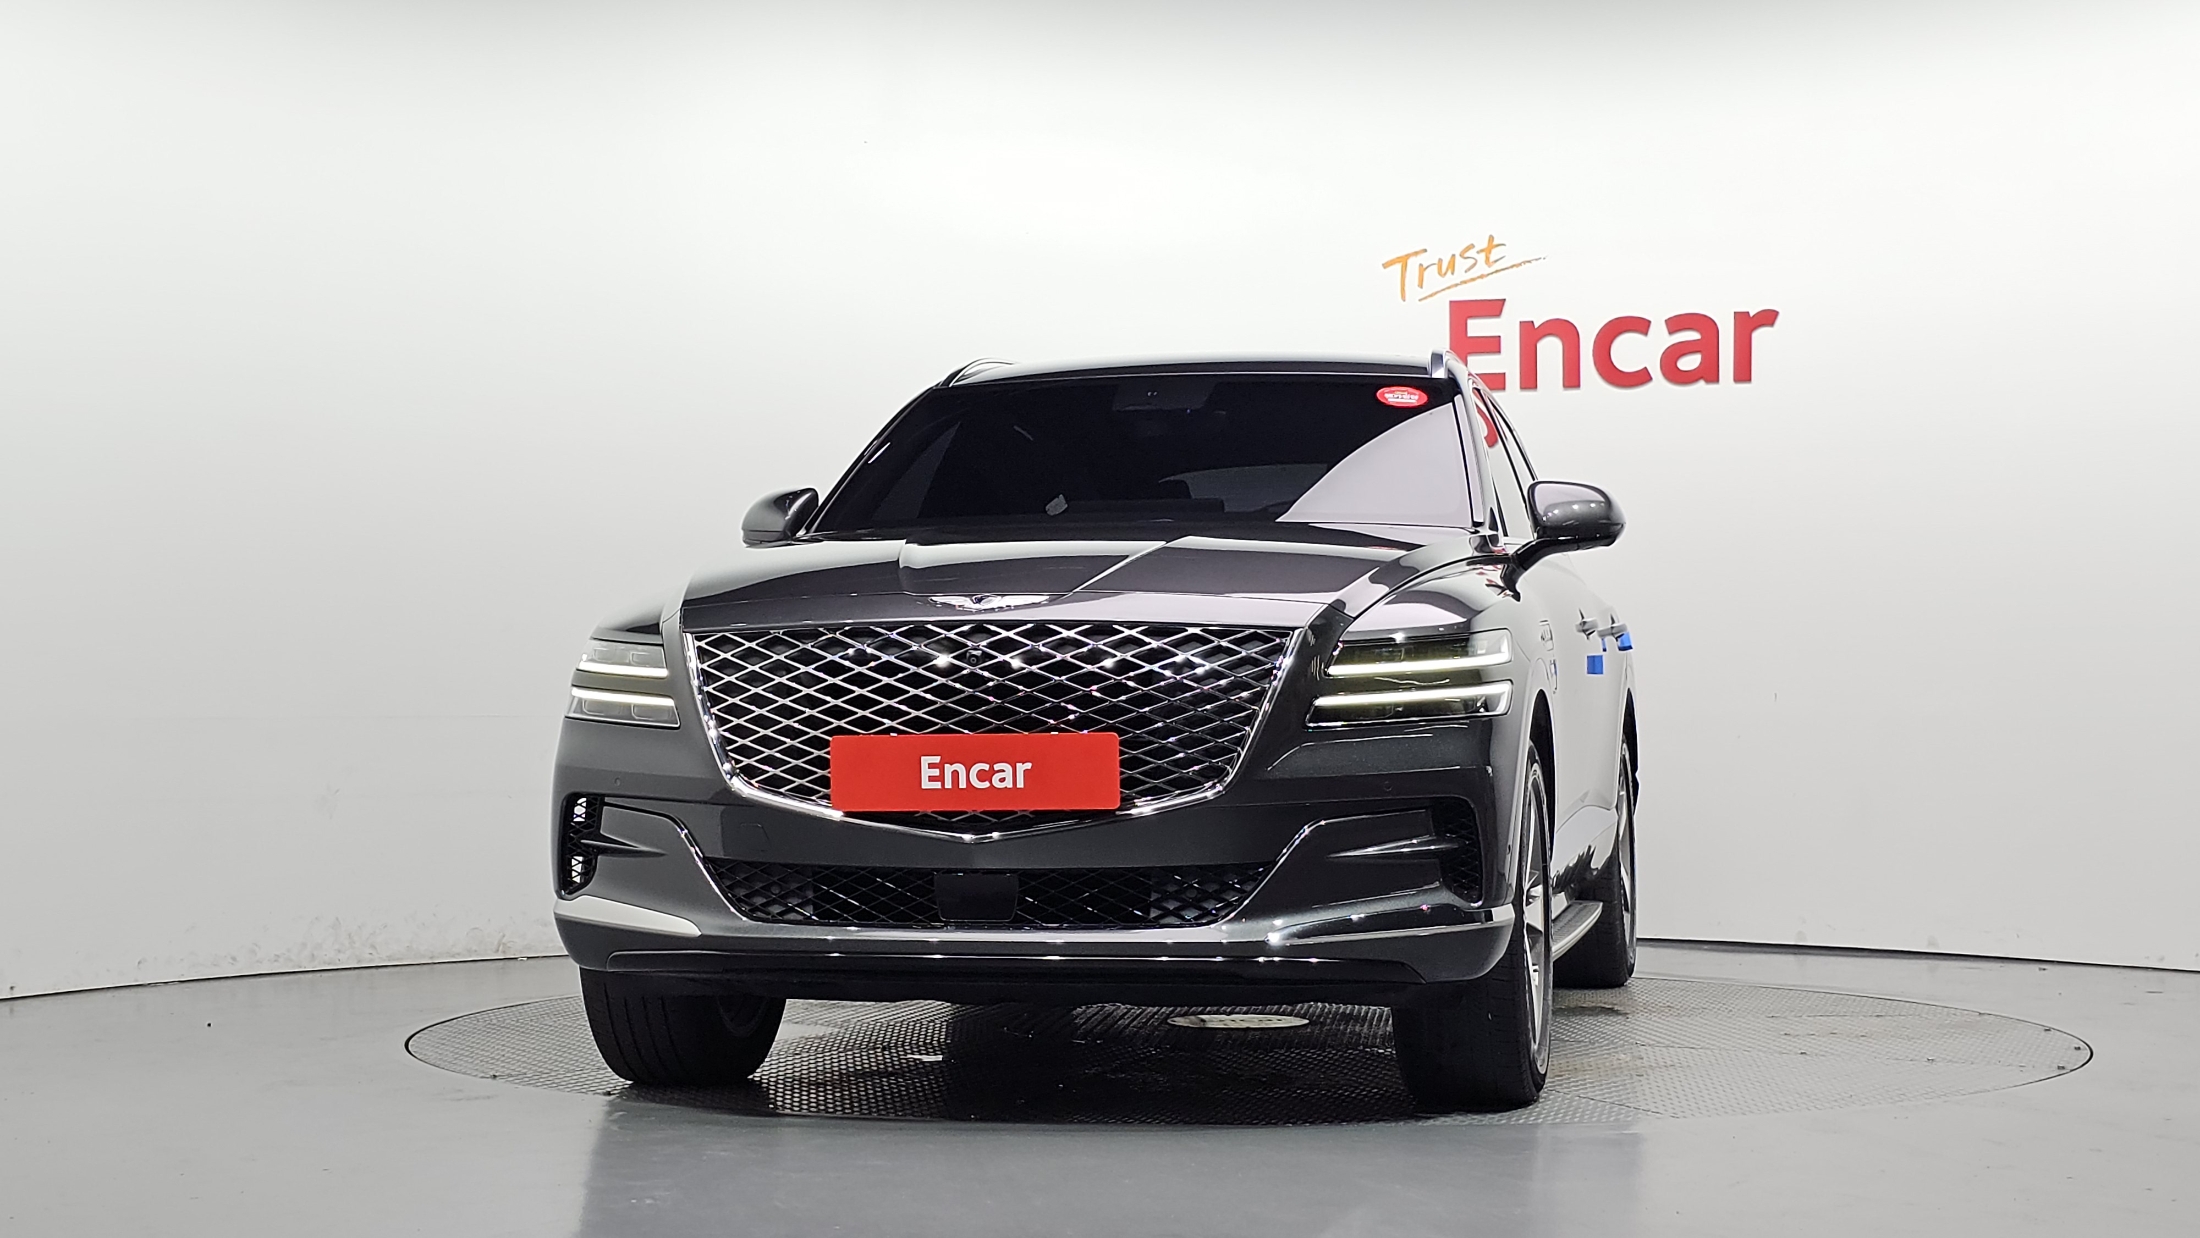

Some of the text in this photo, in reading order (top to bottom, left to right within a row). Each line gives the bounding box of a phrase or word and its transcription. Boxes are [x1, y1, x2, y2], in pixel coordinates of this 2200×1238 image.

[1382, 234, 1507, 301] Trust
[1449, 298, 1780, 391] Encar
[920, 756, 1033, 789] Encar
